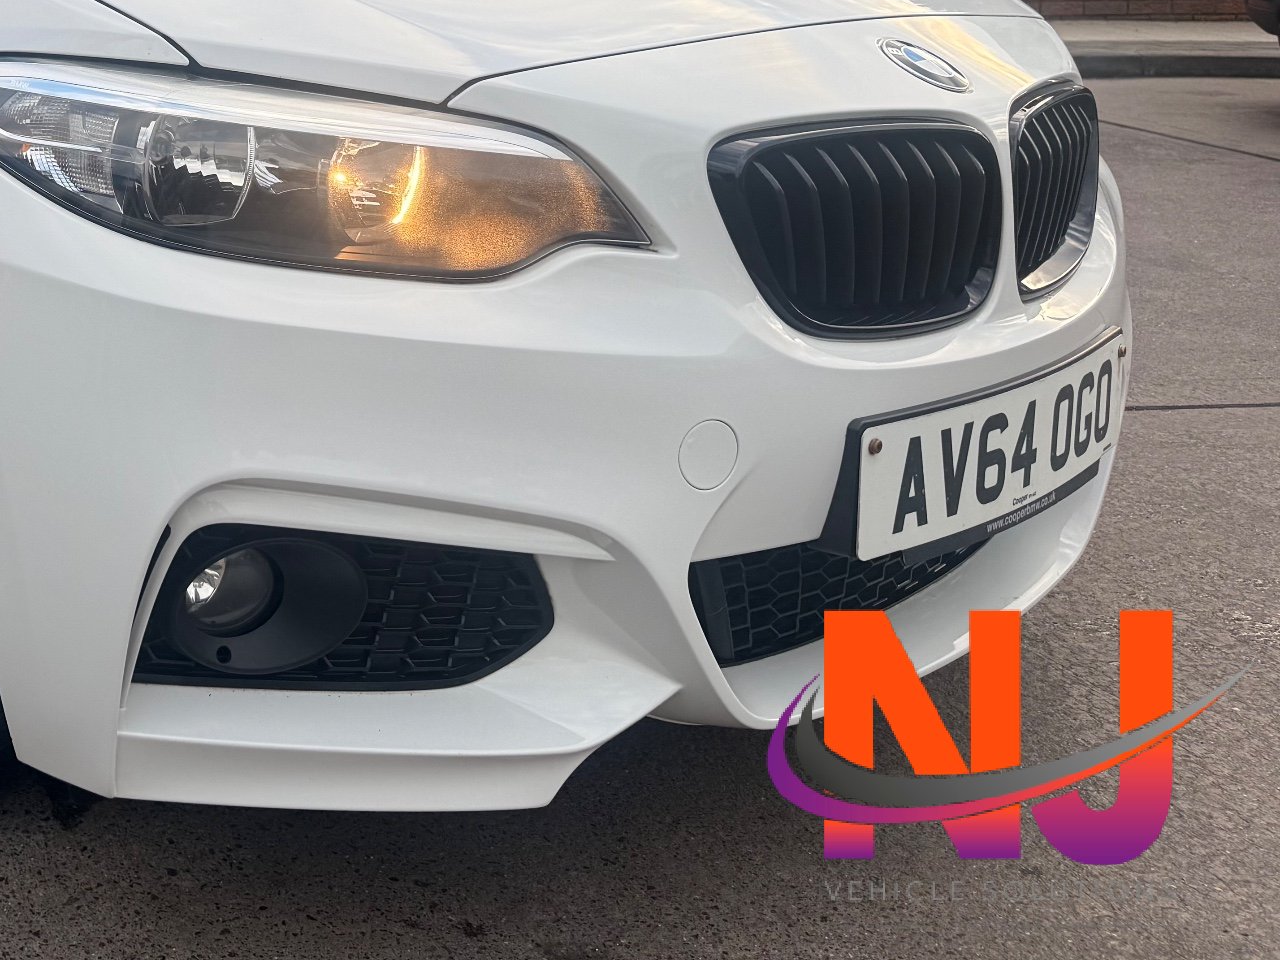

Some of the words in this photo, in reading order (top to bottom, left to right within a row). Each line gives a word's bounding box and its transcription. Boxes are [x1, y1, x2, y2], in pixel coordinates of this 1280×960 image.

[892, 399, 1038, 535] AV64
[1049, 358, 1113, 472] OGO
[986, 491, 1056, 533] www.cooperbmw.co.uk
